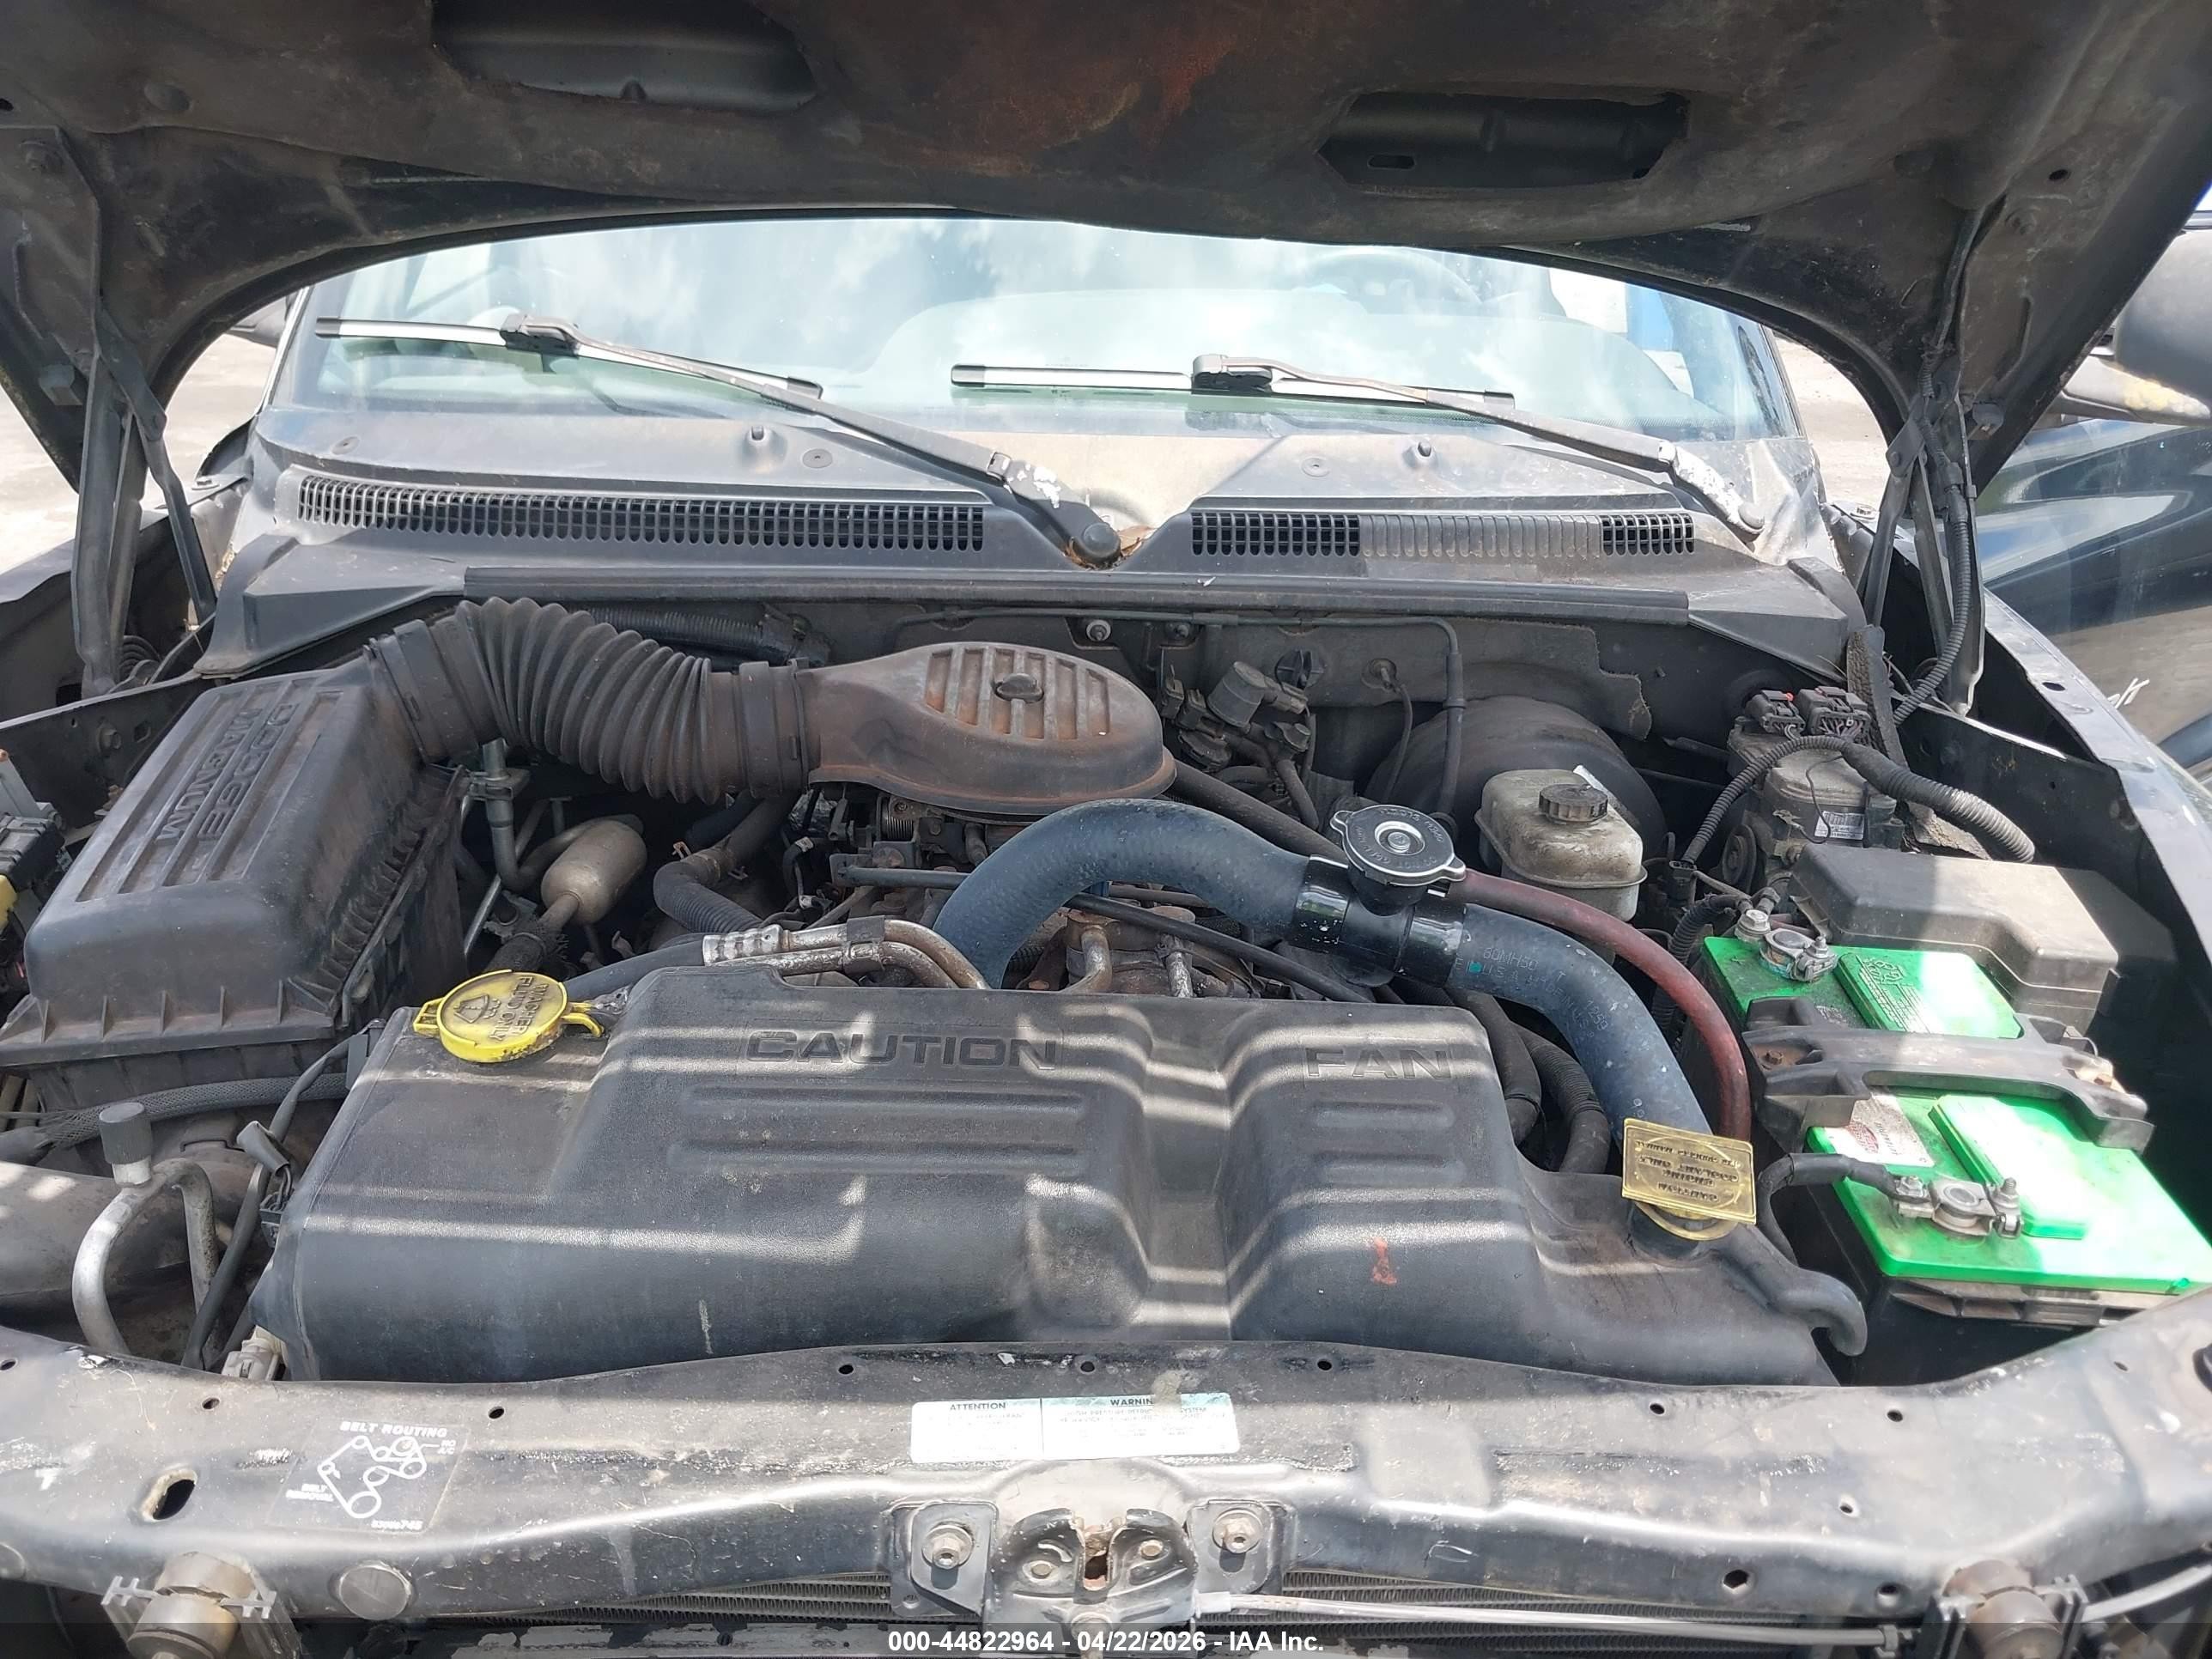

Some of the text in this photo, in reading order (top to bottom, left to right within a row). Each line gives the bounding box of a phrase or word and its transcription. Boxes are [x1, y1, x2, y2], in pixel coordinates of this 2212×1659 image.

[155, 708, 263, 842] MAGNUM
[489, 975, 534, 1042] FLUID ONLY
[746, 1030, 1453, 1079] CAUTION FAN
[950, 1401, 1006, 1411] ATTENTION
[1109, 1398, 1155, 1407] WARNIN
[339, 1421, 447, 1438] BELT ROUTING
